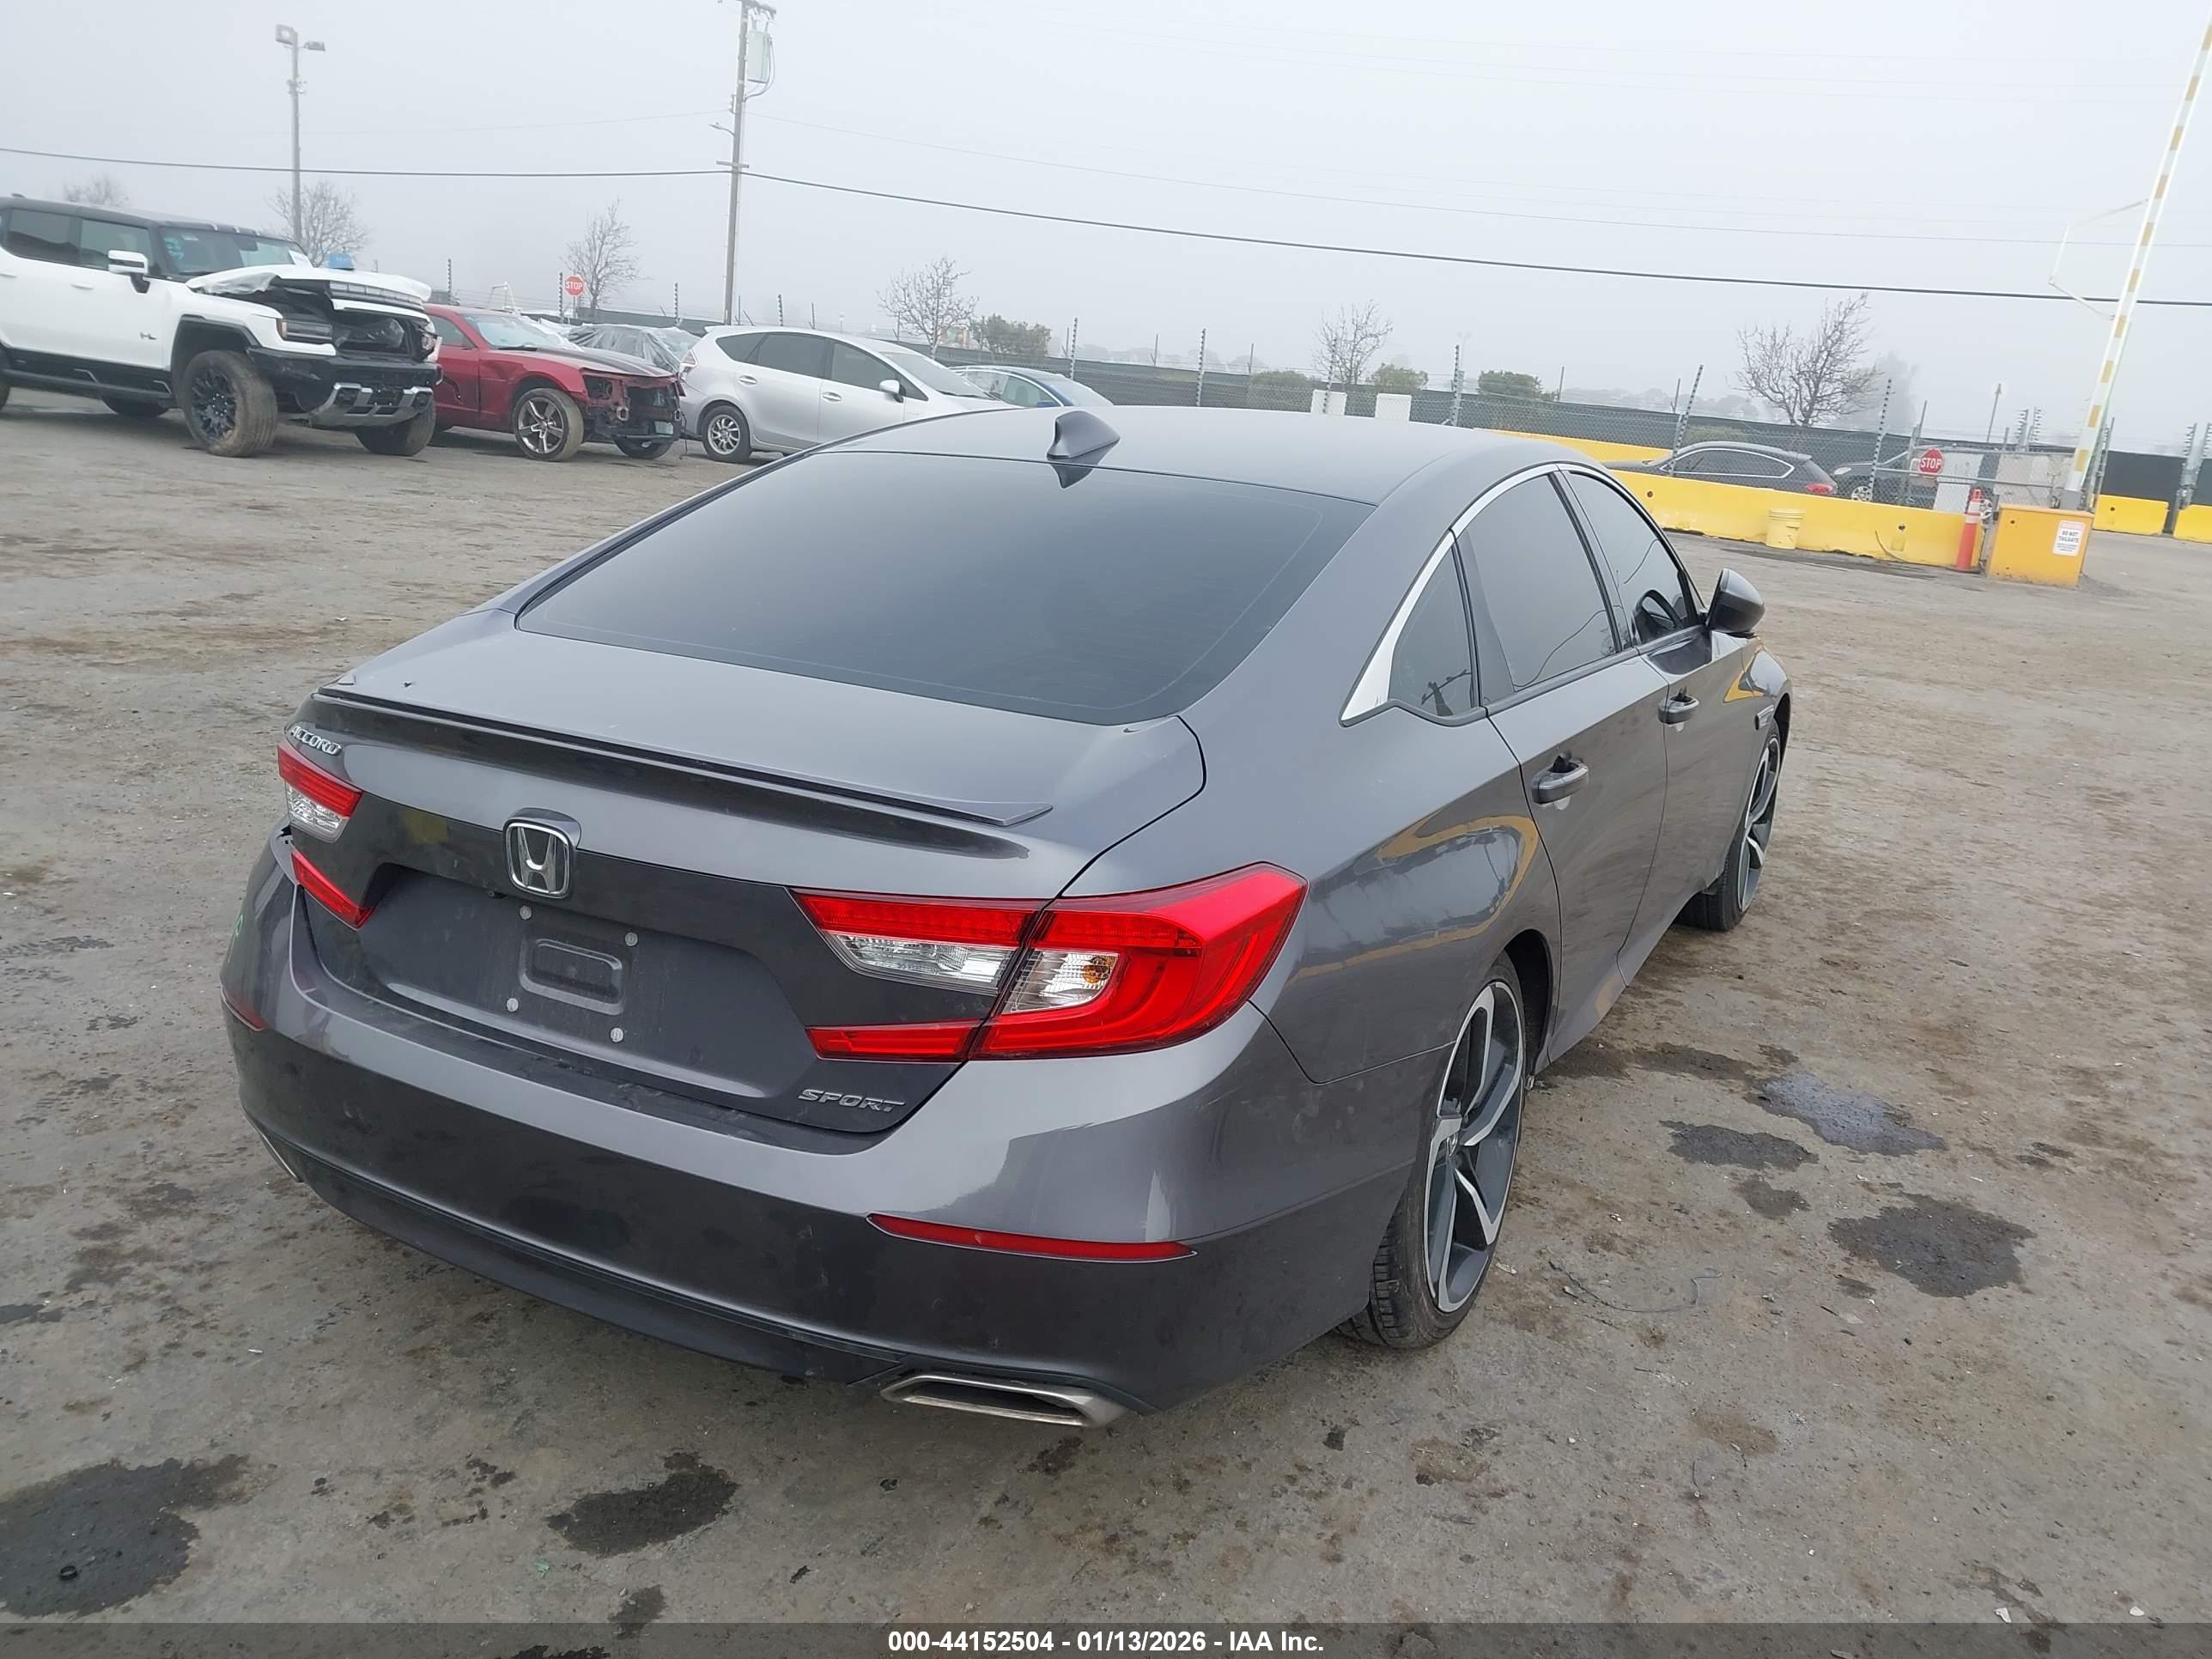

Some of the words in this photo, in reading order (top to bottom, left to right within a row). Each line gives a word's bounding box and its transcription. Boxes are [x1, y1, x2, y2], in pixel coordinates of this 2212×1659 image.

[565, 281, 583, 290] STOP
[1920, 457, 1942, 470] STOP
[291, 726, 342, 755] ACCORD
[797, 1088, 906, 1112] SPORT
